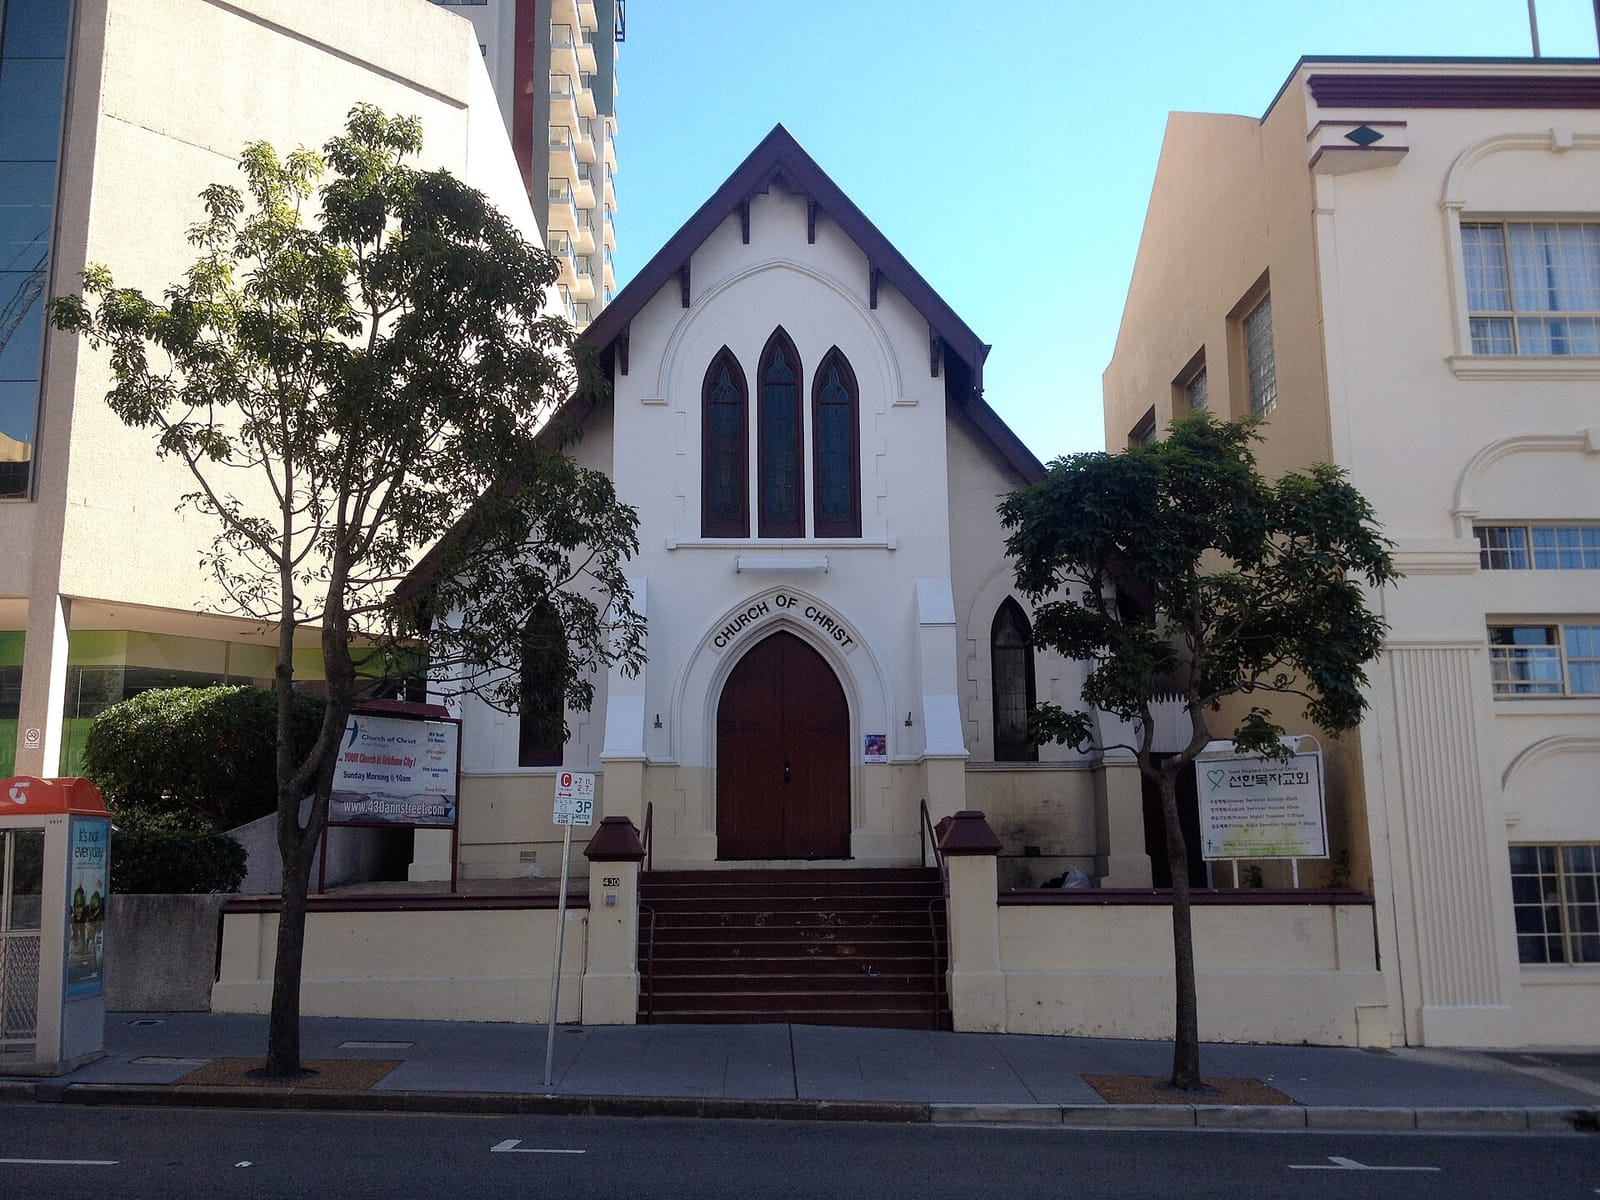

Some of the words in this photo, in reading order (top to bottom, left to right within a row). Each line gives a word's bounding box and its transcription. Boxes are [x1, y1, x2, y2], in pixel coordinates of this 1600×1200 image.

[714, 602, 770, 648] CHURCH
[775, 595, 798, 609] OF
[804, 606, 854, 647] CHRIST
[362, 734, 385, 742] Church
[344, 752, 358, 762] YOUR
[360, 753, 376, 764] Church
[376, 756, 381, 764] in
[343, 771, 364, 781] Sunday
[366, 772, 389, 783] Morning
[563, 774, 570, 786] C
[1229, 772, 1309, 788] 선한목자교회
[344, 801, 445, 815] www.430annstreet.com
[576, 801, 592, 813] 3P
[89, 829, 100, 842] not
[75, 847, 103, 861] everyday
[603, 878, 620, 886] 430
